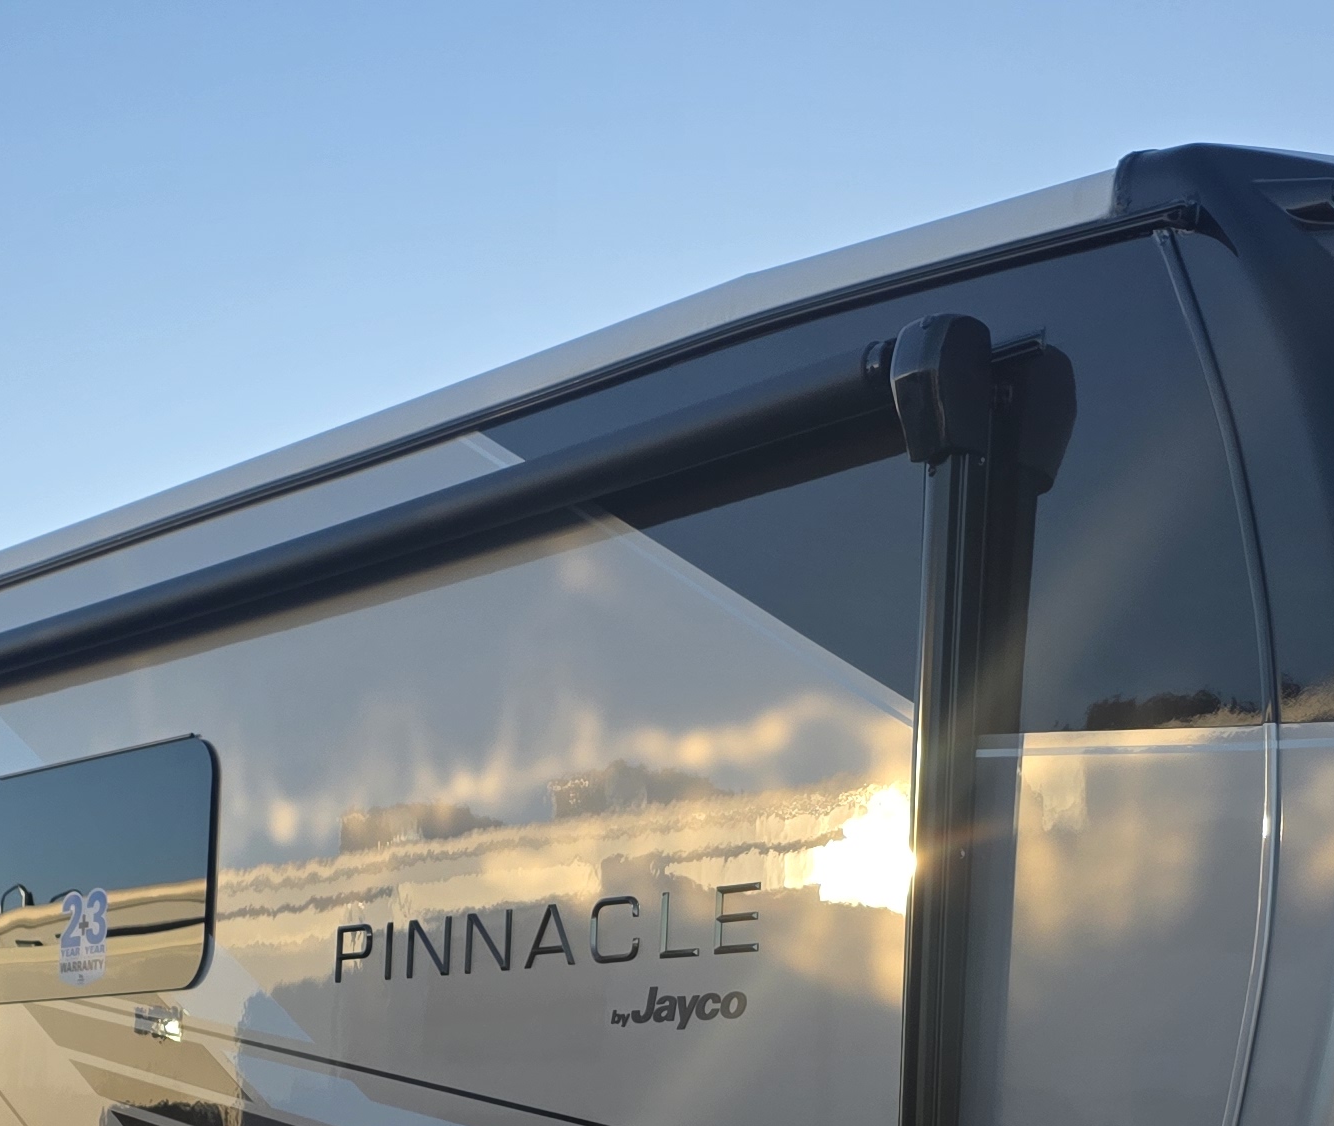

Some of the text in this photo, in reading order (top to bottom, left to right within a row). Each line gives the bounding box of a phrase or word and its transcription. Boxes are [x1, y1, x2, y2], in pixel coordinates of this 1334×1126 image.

[334, 881, 763, 984] PINNACLE
[61, 944, 105, 958] YEAR YEAR
[60, 959, 104, 975] WARRANTY
[610, 986, 747, 1030] by Jayco
